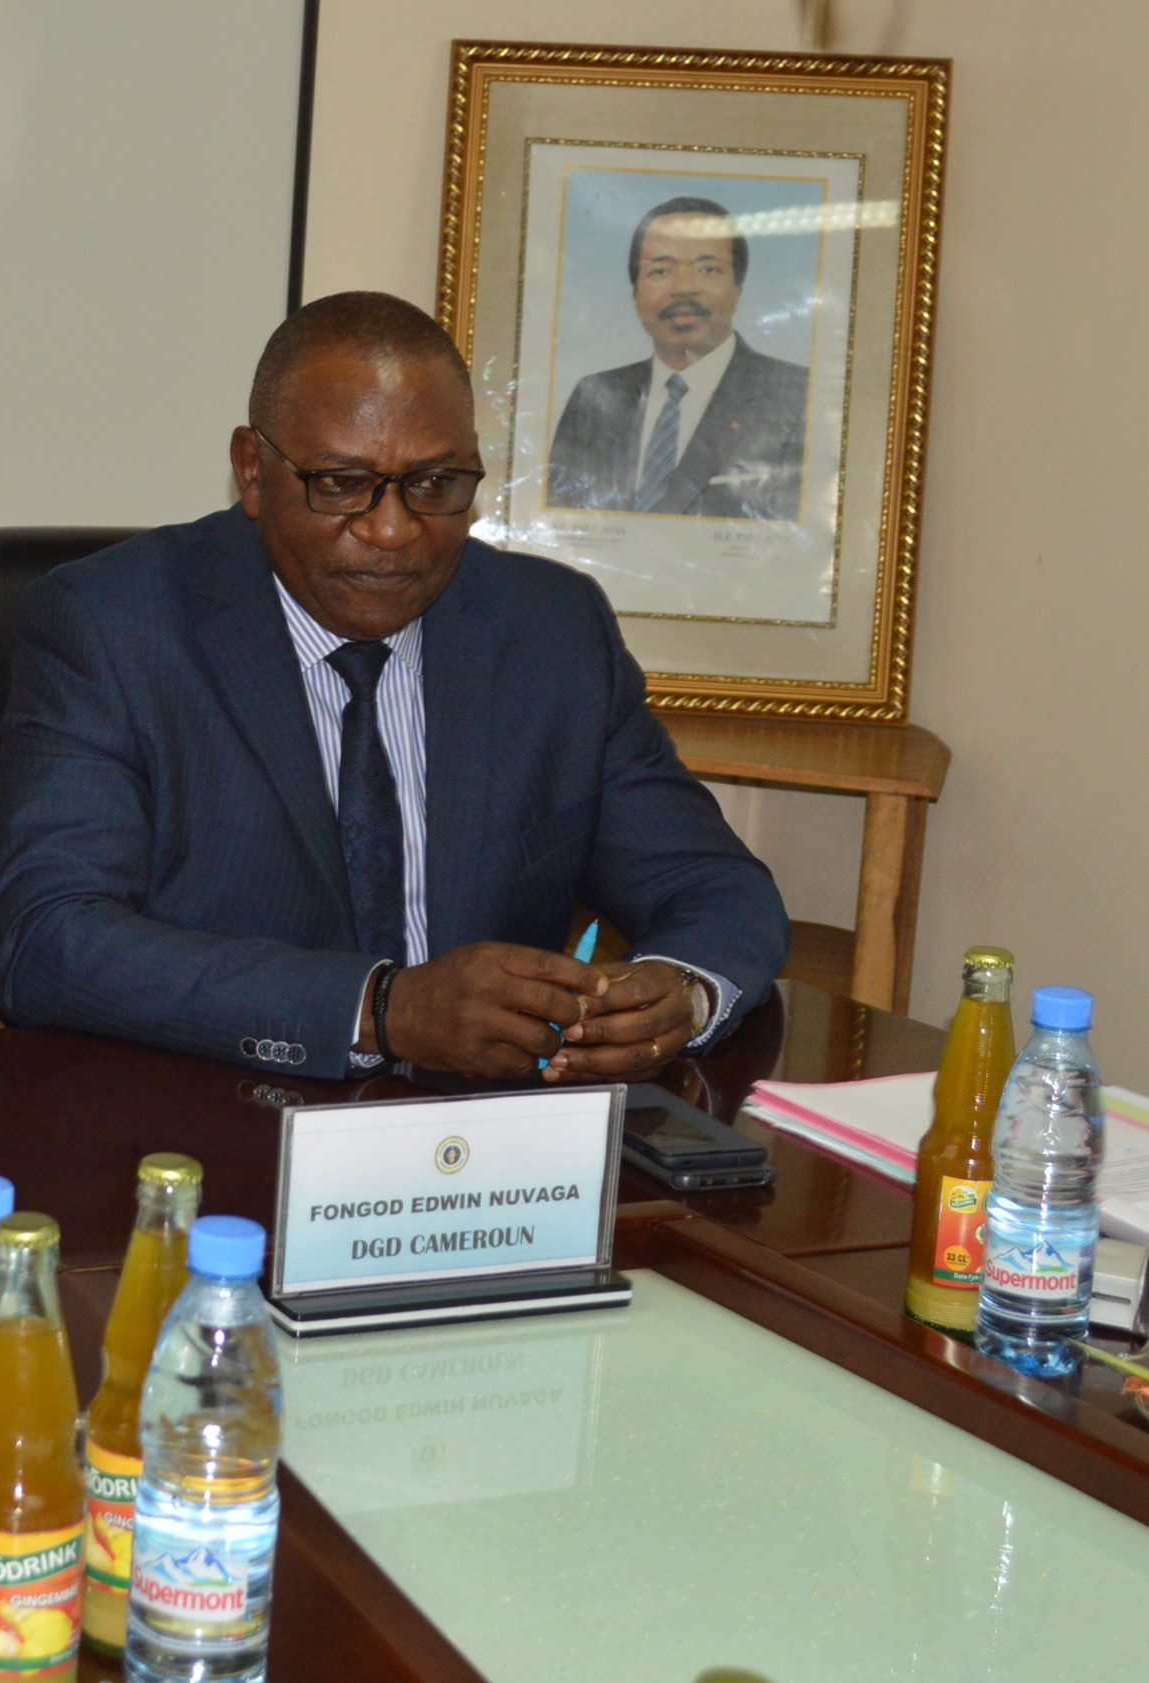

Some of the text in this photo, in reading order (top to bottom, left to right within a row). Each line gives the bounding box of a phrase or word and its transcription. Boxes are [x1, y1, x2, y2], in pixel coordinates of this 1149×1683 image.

[310, 1184, 580, 1222] FONGOD EDWIN NUVAGA
[351, 1225, 536, 1260] DGD CAMEROUN
[946, 1252, 967, 1263] 33 CL
[984, 1259, 1077, 1292] Supermont
[104, 1511, 134, 1529] GING
[132, 1565, 244, 1611] Supermont
